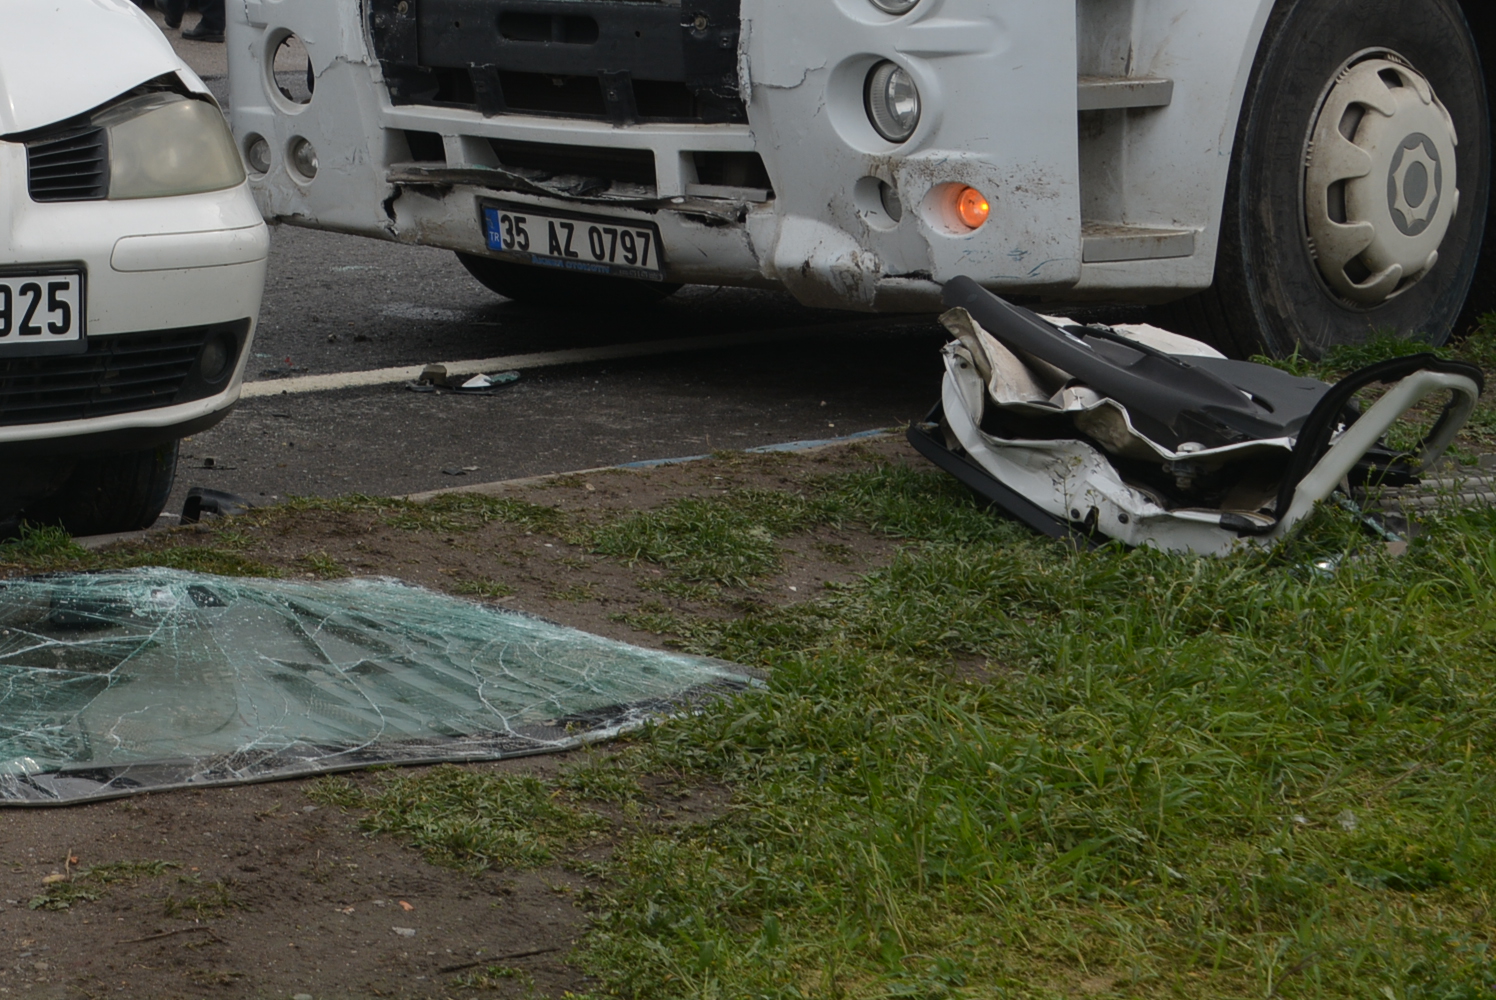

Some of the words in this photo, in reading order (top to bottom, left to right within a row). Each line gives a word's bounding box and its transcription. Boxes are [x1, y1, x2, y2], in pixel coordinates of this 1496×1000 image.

[489, 230, 500, 243] TR
[500, 213, 530, 252] 35
[548, 220, 579, 258] AZ
[588, 225, 651, 267] 0797
